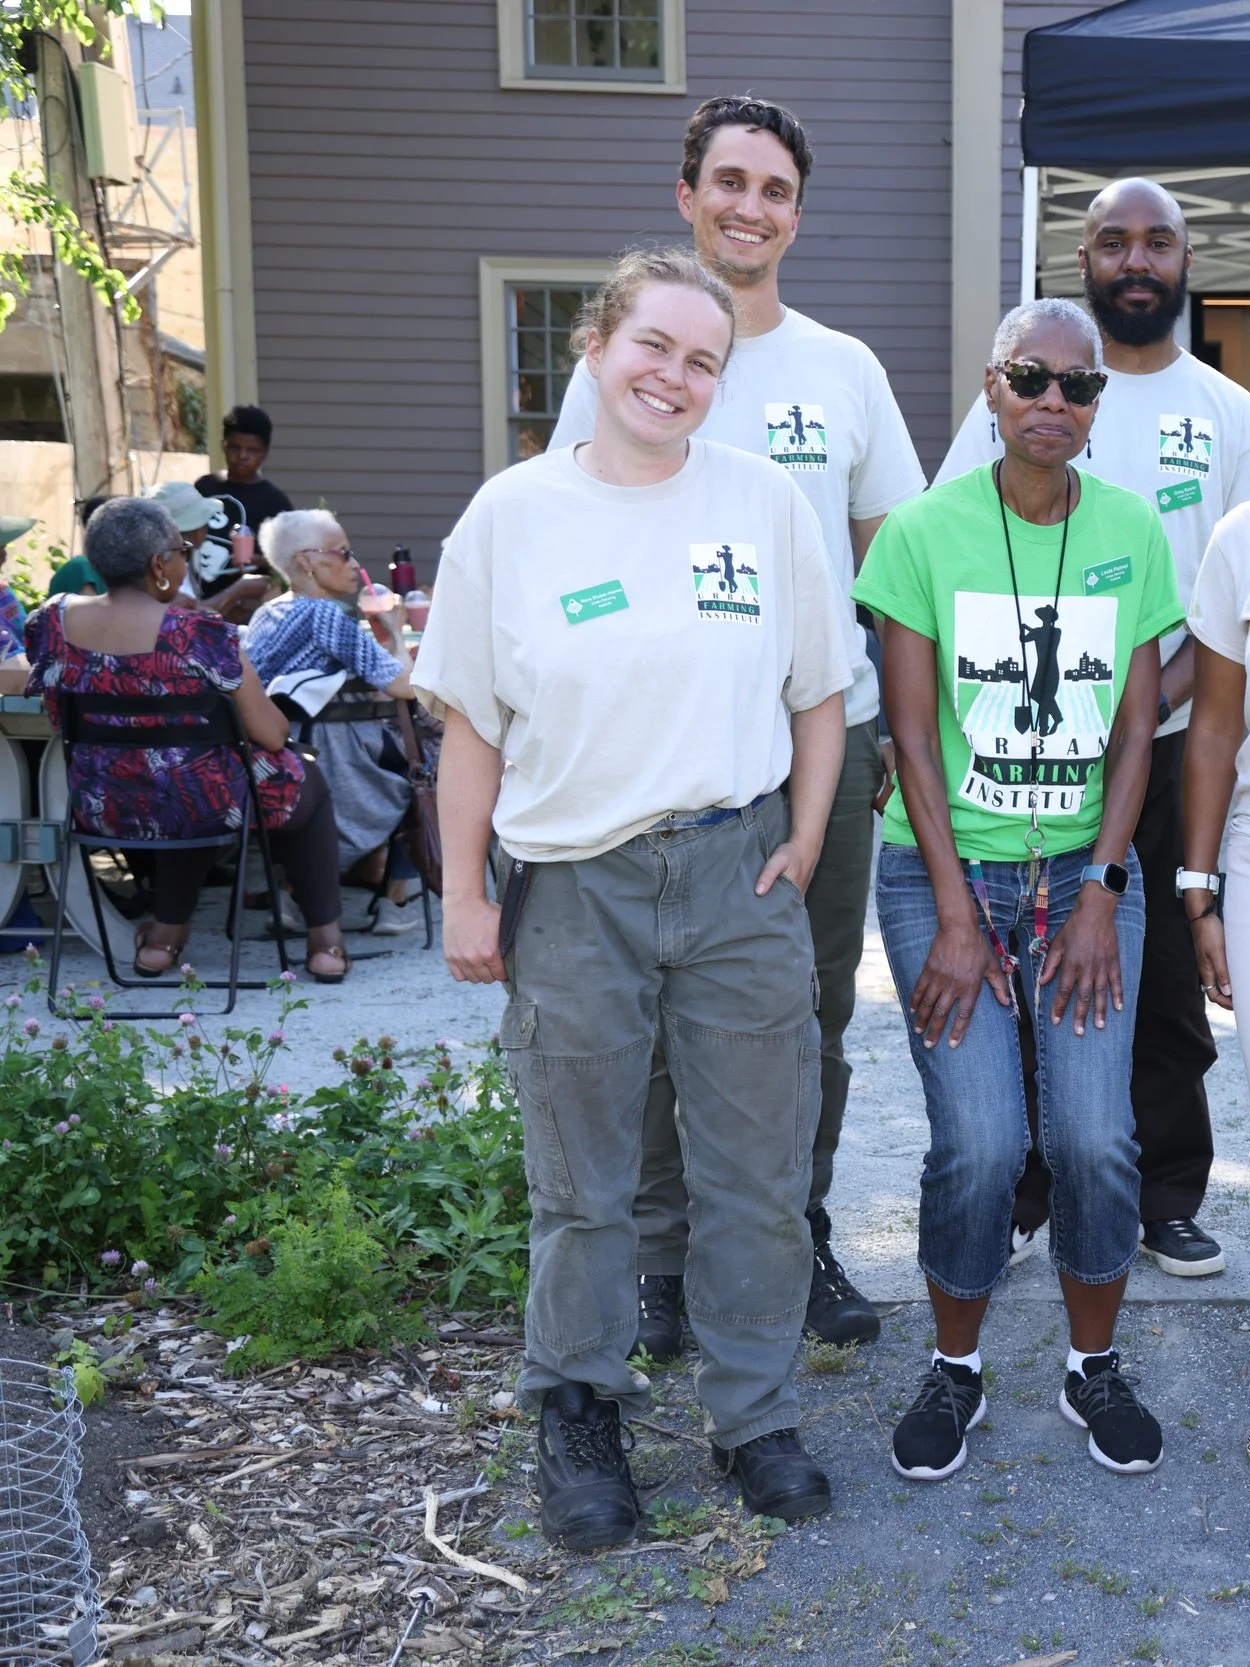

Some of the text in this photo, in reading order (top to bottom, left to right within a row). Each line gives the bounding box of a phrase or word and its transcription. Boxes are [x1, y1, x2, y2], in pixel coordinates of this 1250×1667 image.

[784, 463, 826, 471] STITUTE
[697, 592, 759, 604] URBAN
[703, 602, 755, 614] FARMING
[700, 612, 759, 624] INSTITUTE
